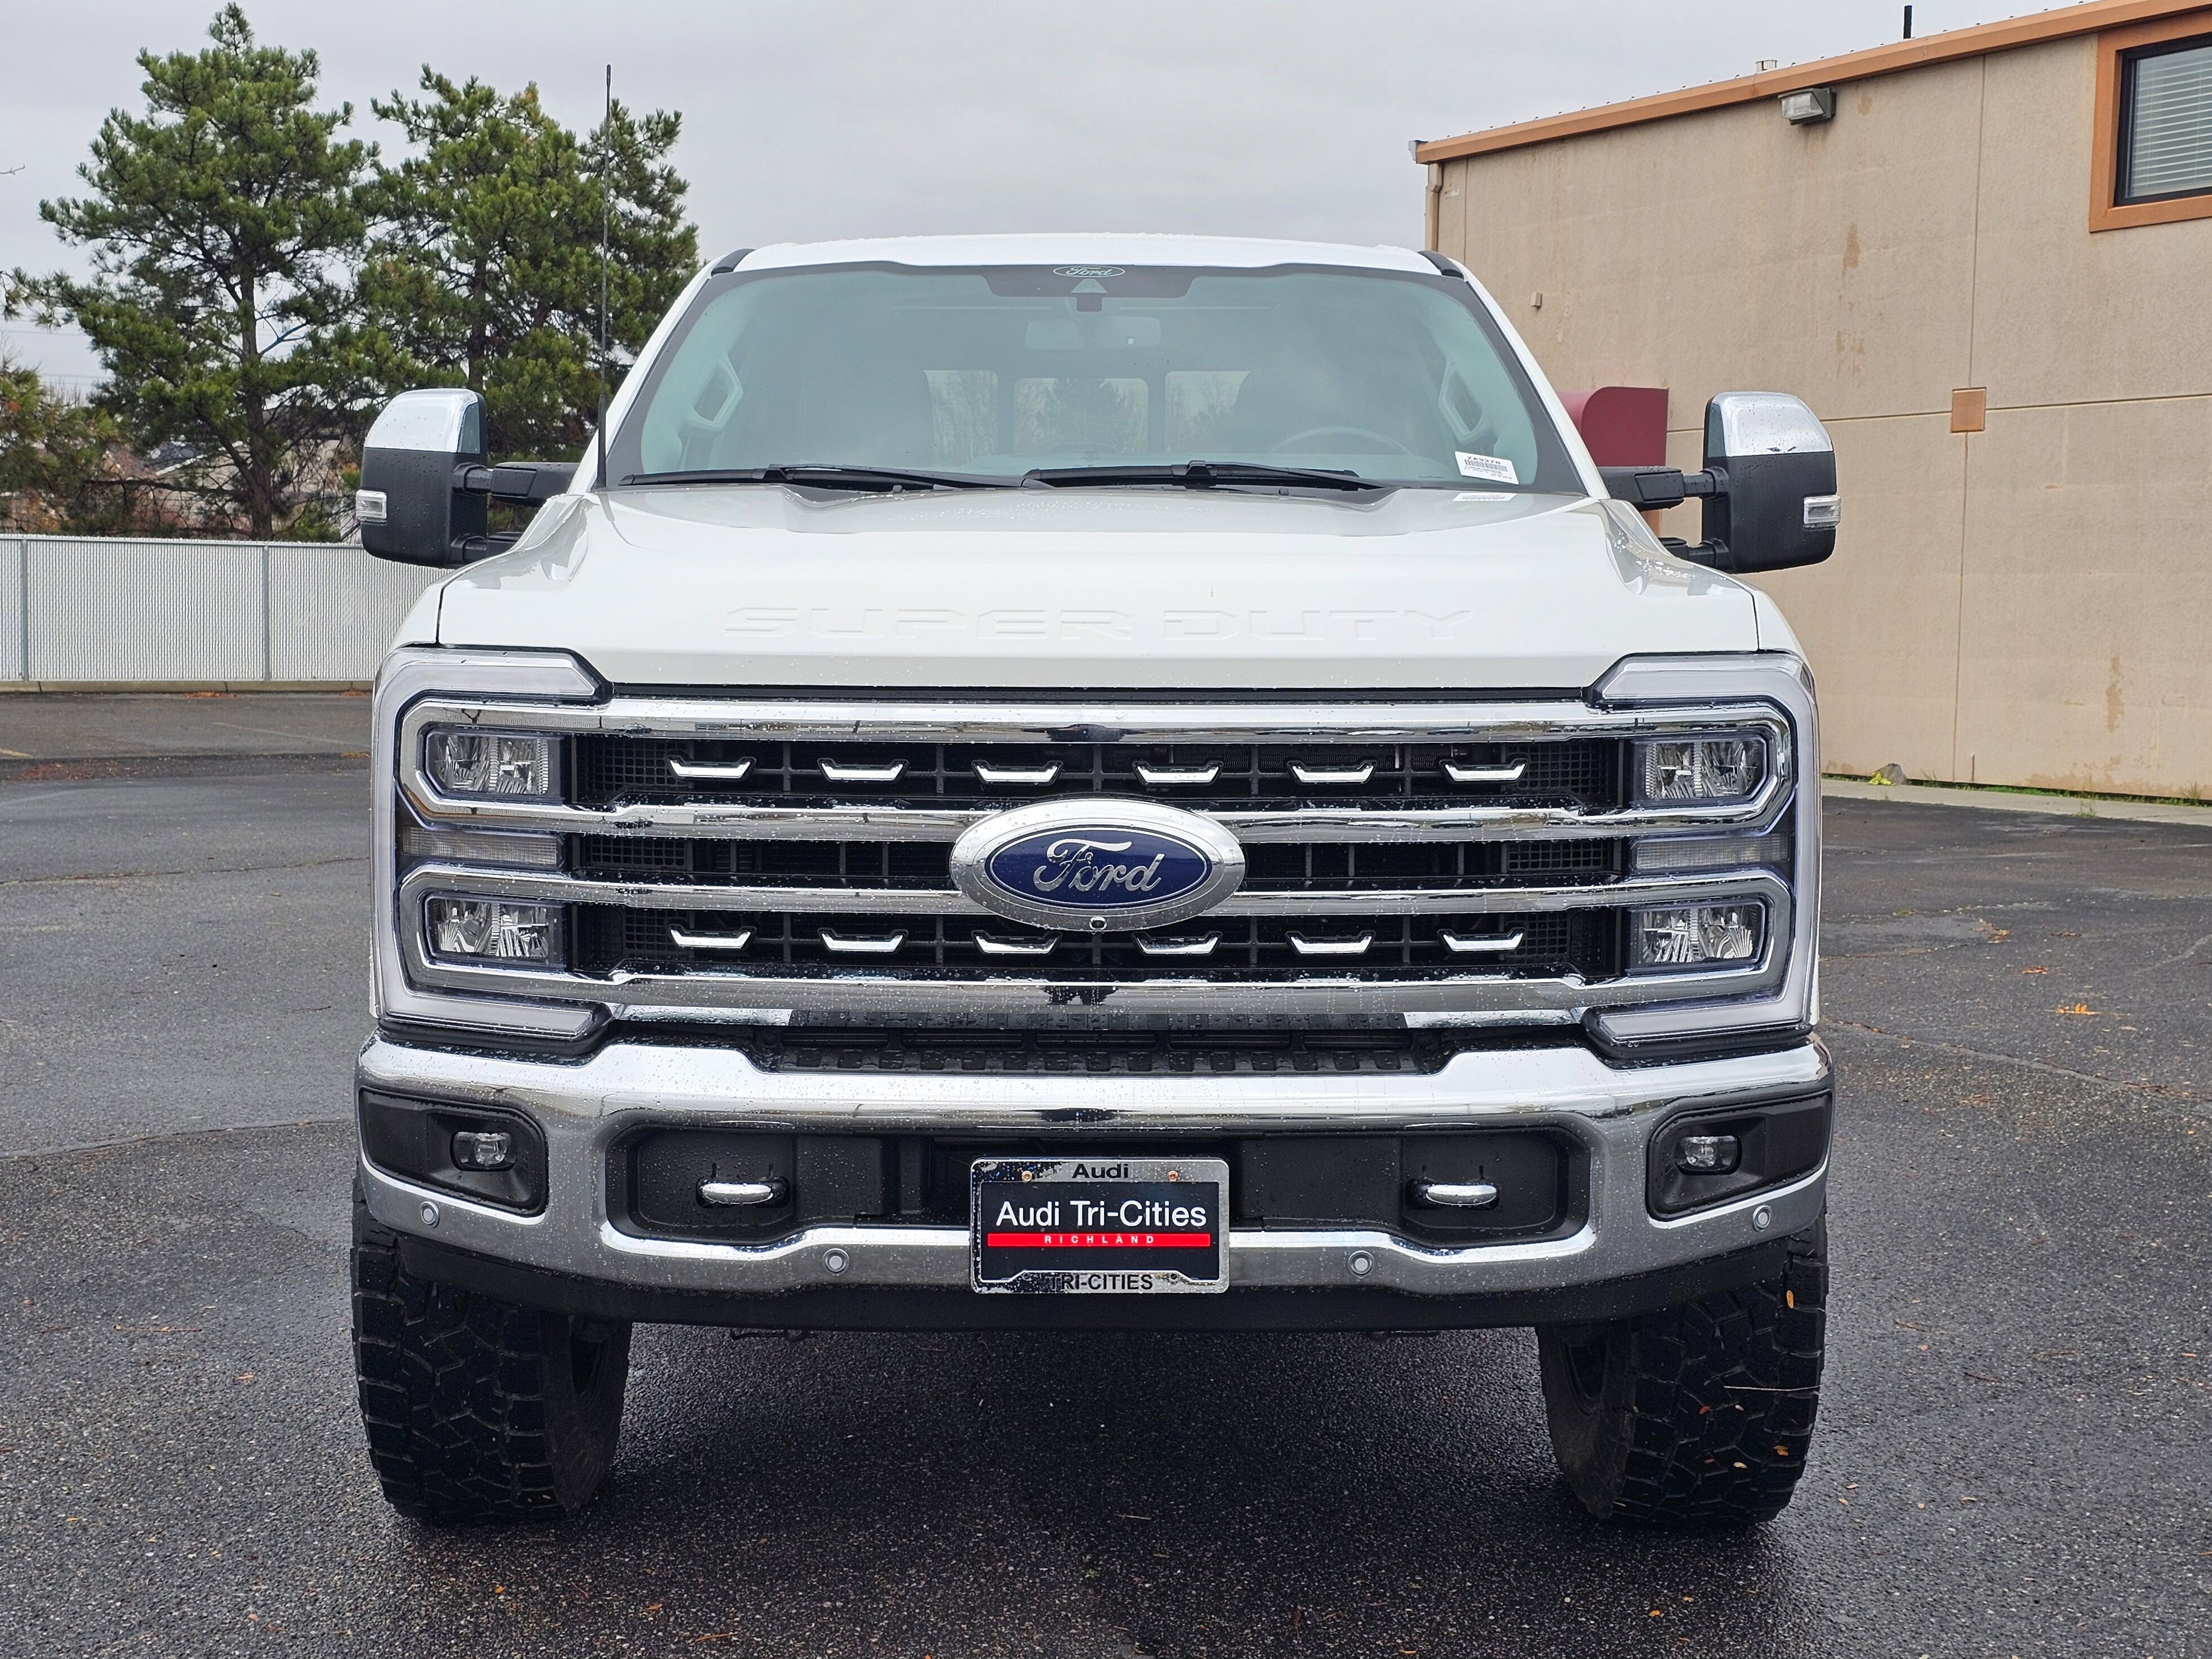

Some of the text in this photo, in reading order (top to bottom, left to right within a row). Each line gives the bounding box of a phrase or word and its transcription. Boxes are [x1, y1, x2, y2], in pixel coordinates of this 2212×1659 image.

[1066, 266, 1113, 275] Ford
[724, 607, 1474, 641] SUPER DUTY
[1032, 839, 1166, 891] Ford
[1071, 1163, 1129, 1179] Audi
[996, 1199, 1207, 1227] Audi Tri-Cities
[1044, 1235, 1155, 1244] RICHLAND
[1050, 1274, 1154, 1290] TRI-CITIES
